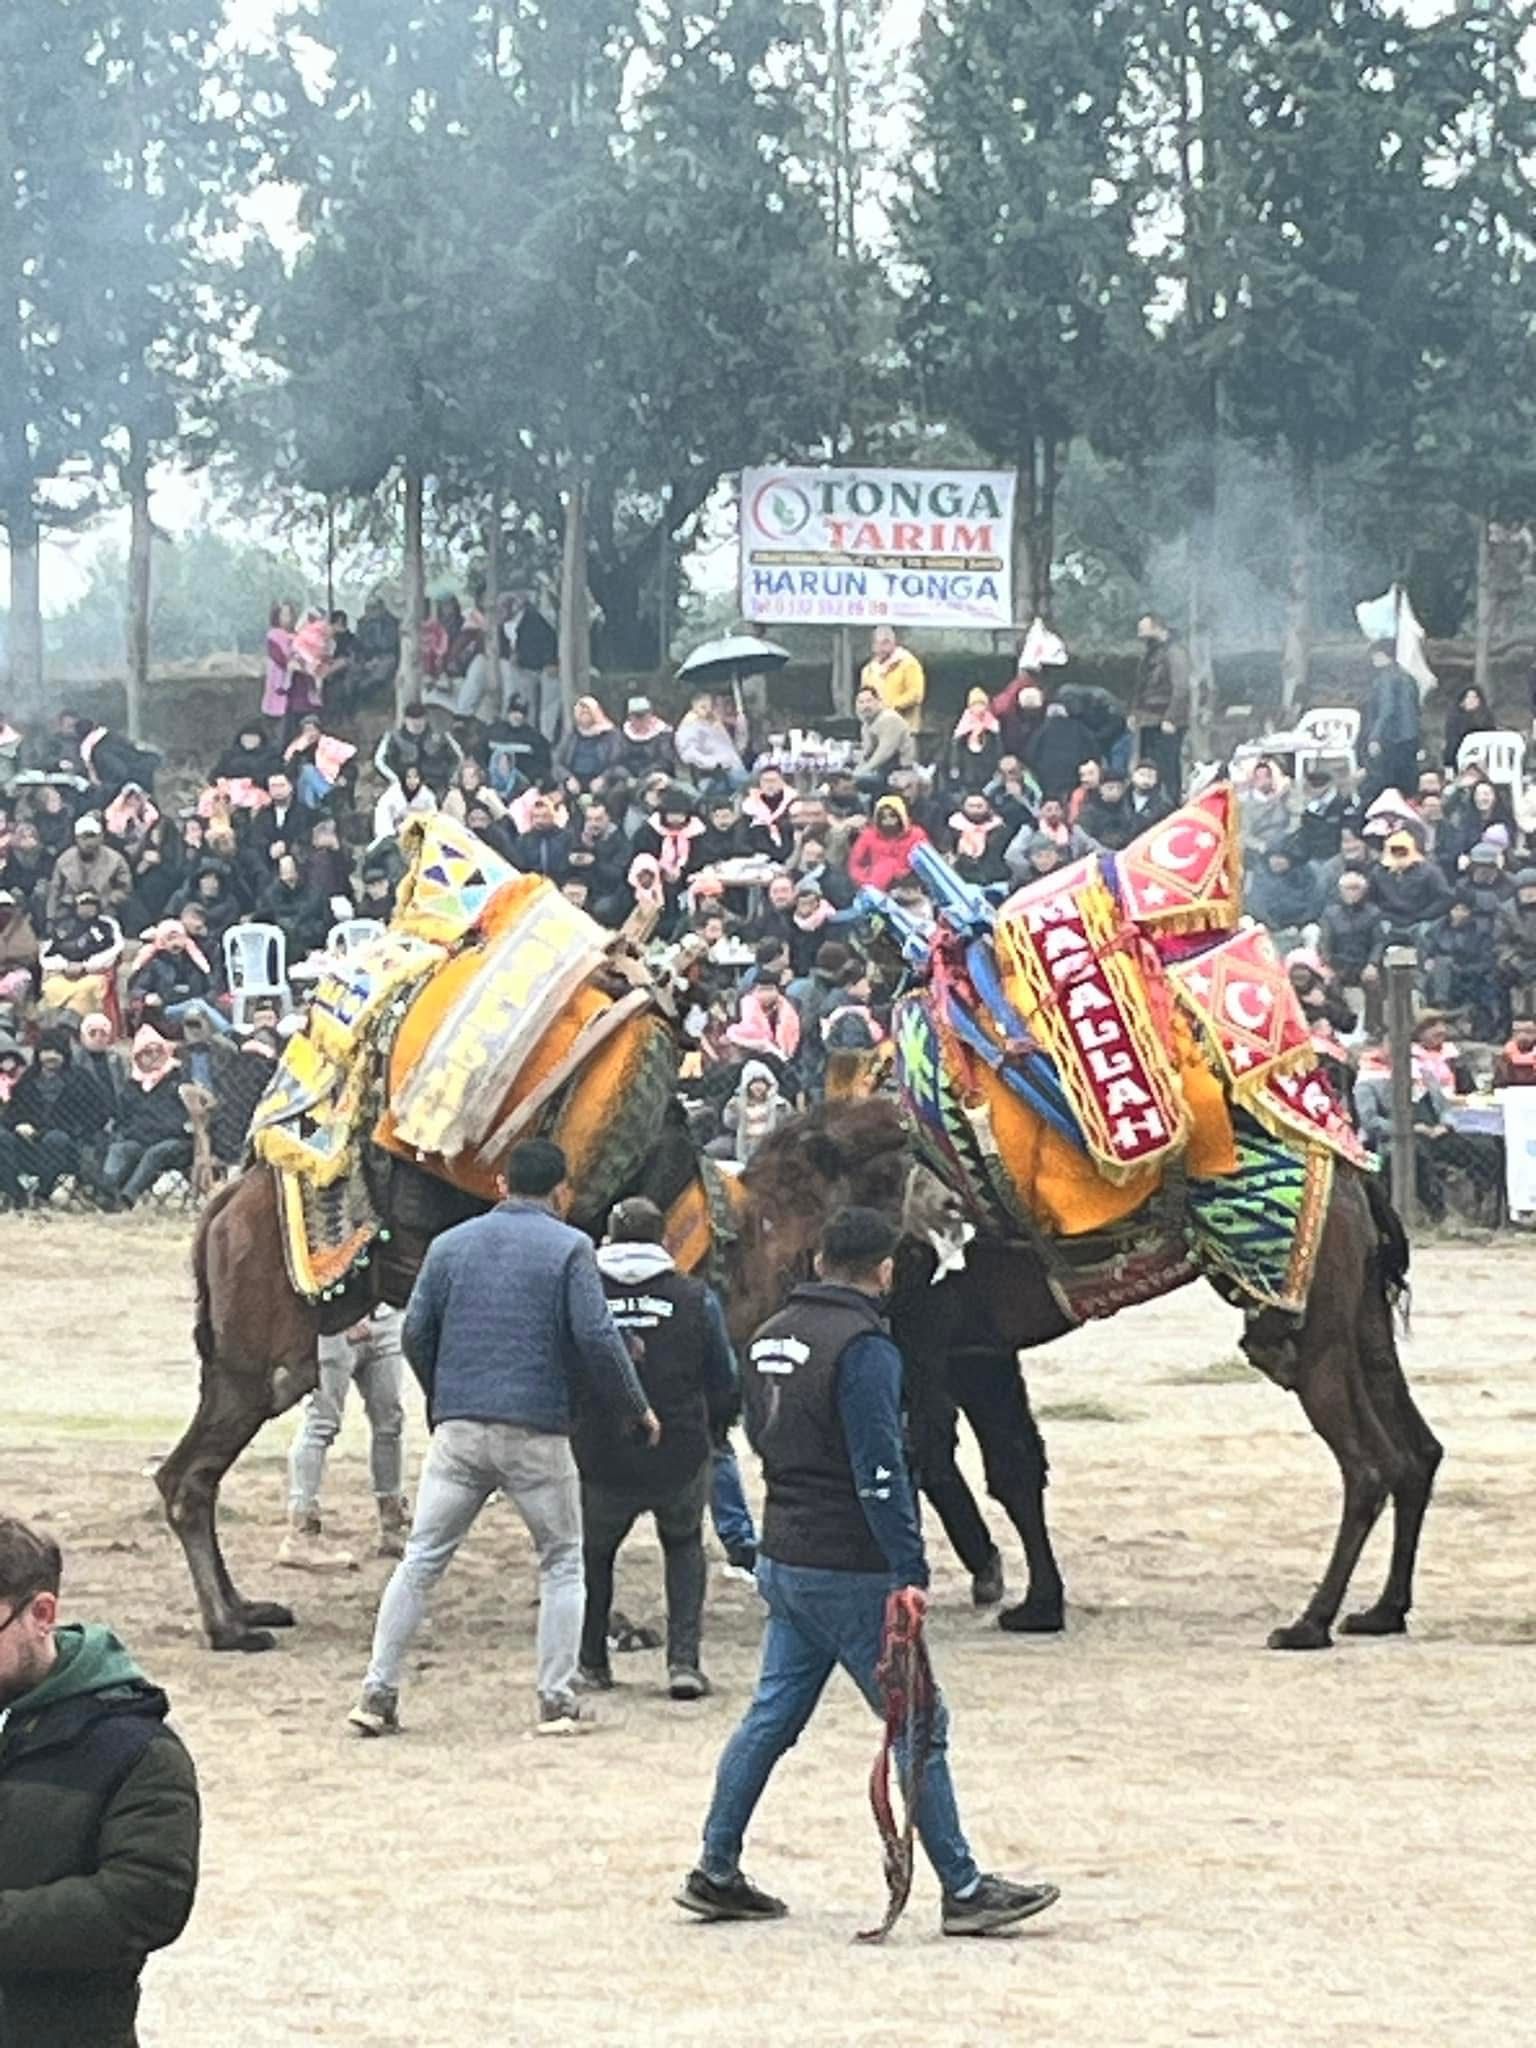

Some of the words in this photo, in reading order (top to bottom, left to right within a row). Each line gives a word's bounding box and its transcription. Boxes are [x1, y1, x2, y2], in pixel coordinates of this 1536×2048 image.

[815, 480, 1003, 519] TONGA
[823, 519, 993, 552] TARIM
[753, 570, 867, 596] HARUN
[882, 573, 999, 600] TONGA
